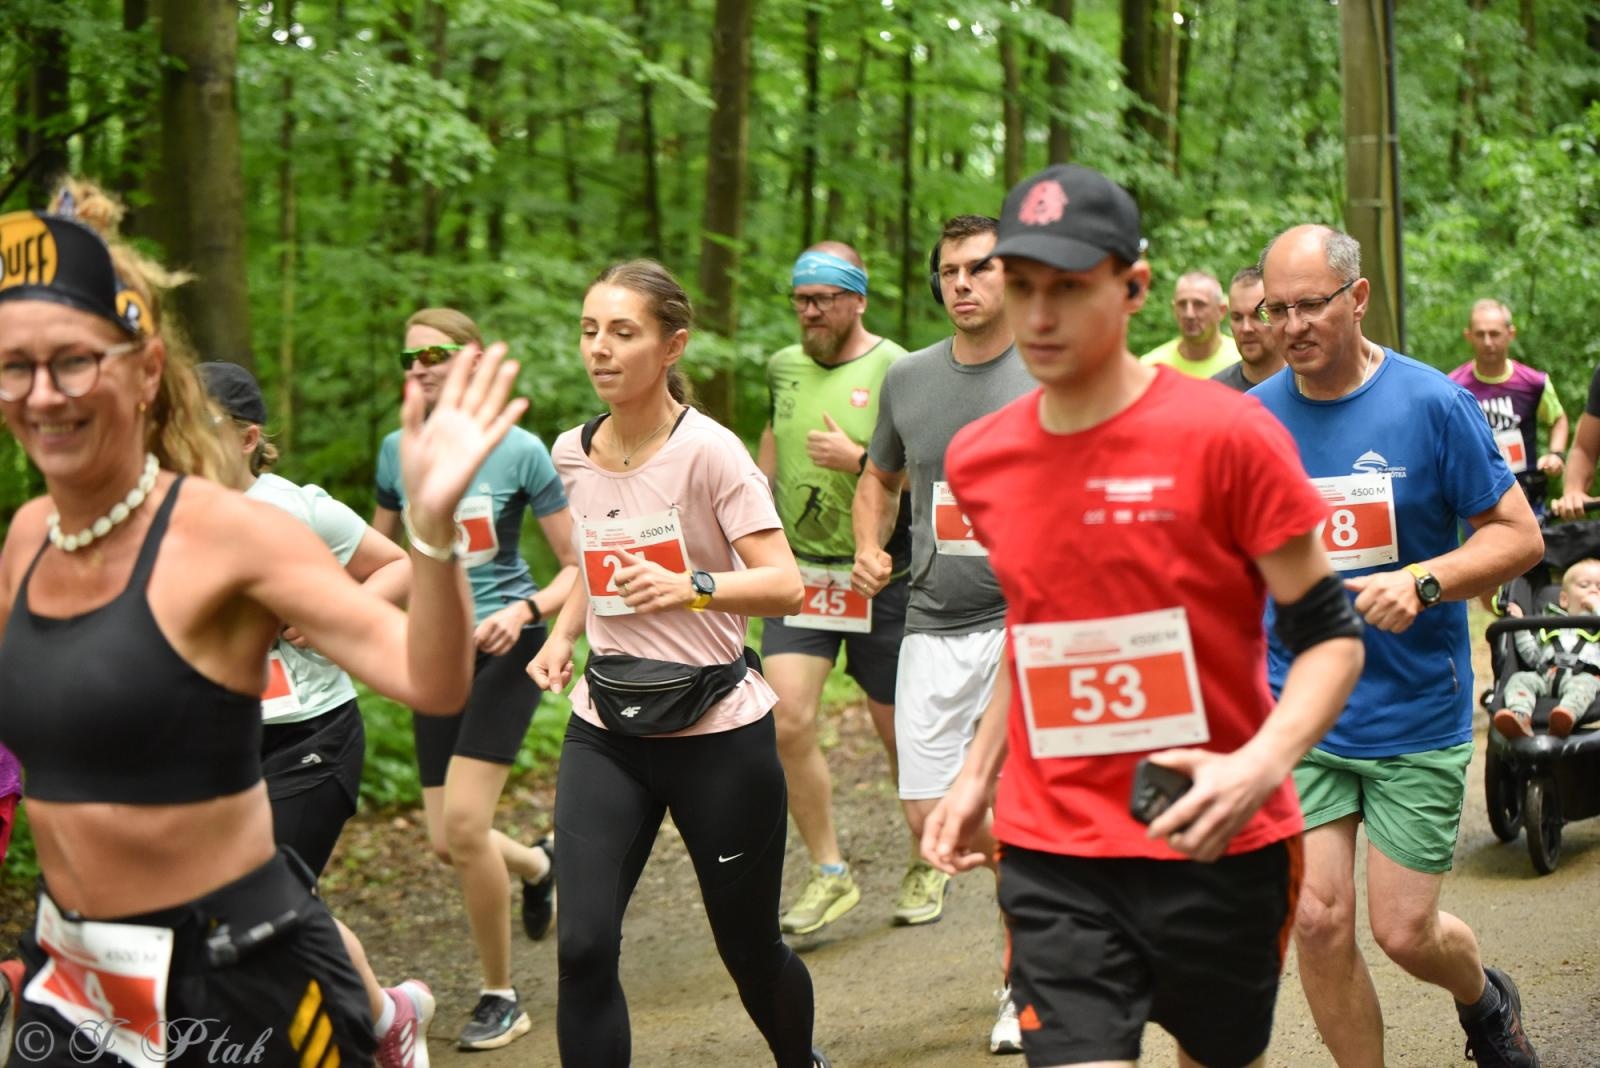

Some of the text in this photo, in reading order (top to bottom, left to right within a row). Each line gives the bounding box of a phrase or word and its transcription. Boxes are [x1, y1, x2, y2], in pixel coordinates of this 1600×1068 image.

[0, 231, 48, 285] UFF
[1351, 488, 1374, 497] 4500
[1376, 487, 1386, 495] M
[640, 526, 664, 540] 4500
[664, 524, 675, 533] M
[809, 589, 847, 616] 45
[1069, 663, 1147, 724] 53
